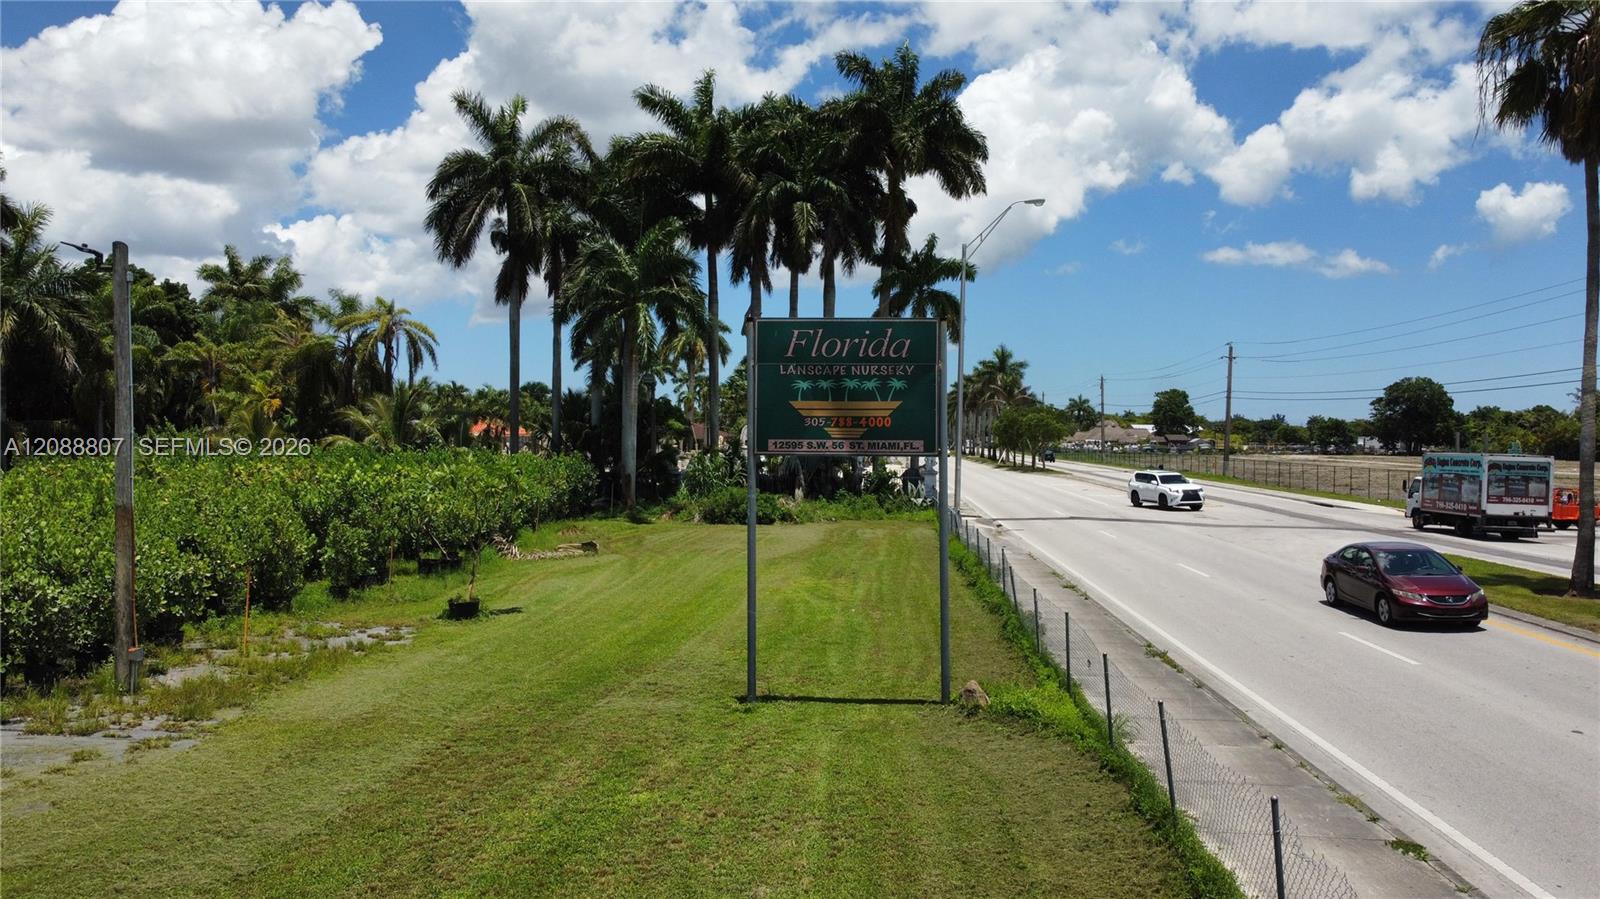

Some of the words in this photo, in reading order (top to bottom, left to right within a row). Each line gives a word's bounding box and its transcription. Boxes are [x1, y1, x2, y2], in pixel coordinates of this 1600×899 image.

[784, 328, 911, 358] Florida
[780, 364, 847, 376] LANSCAPE
[851, 364, 915, 376] NURSERY
[772, 440, 804, 449] 12595
[806, 440, 829, 449] S.W.
[831, 440, 845, 450] 56
[848, 440, 865, 450] ST.
